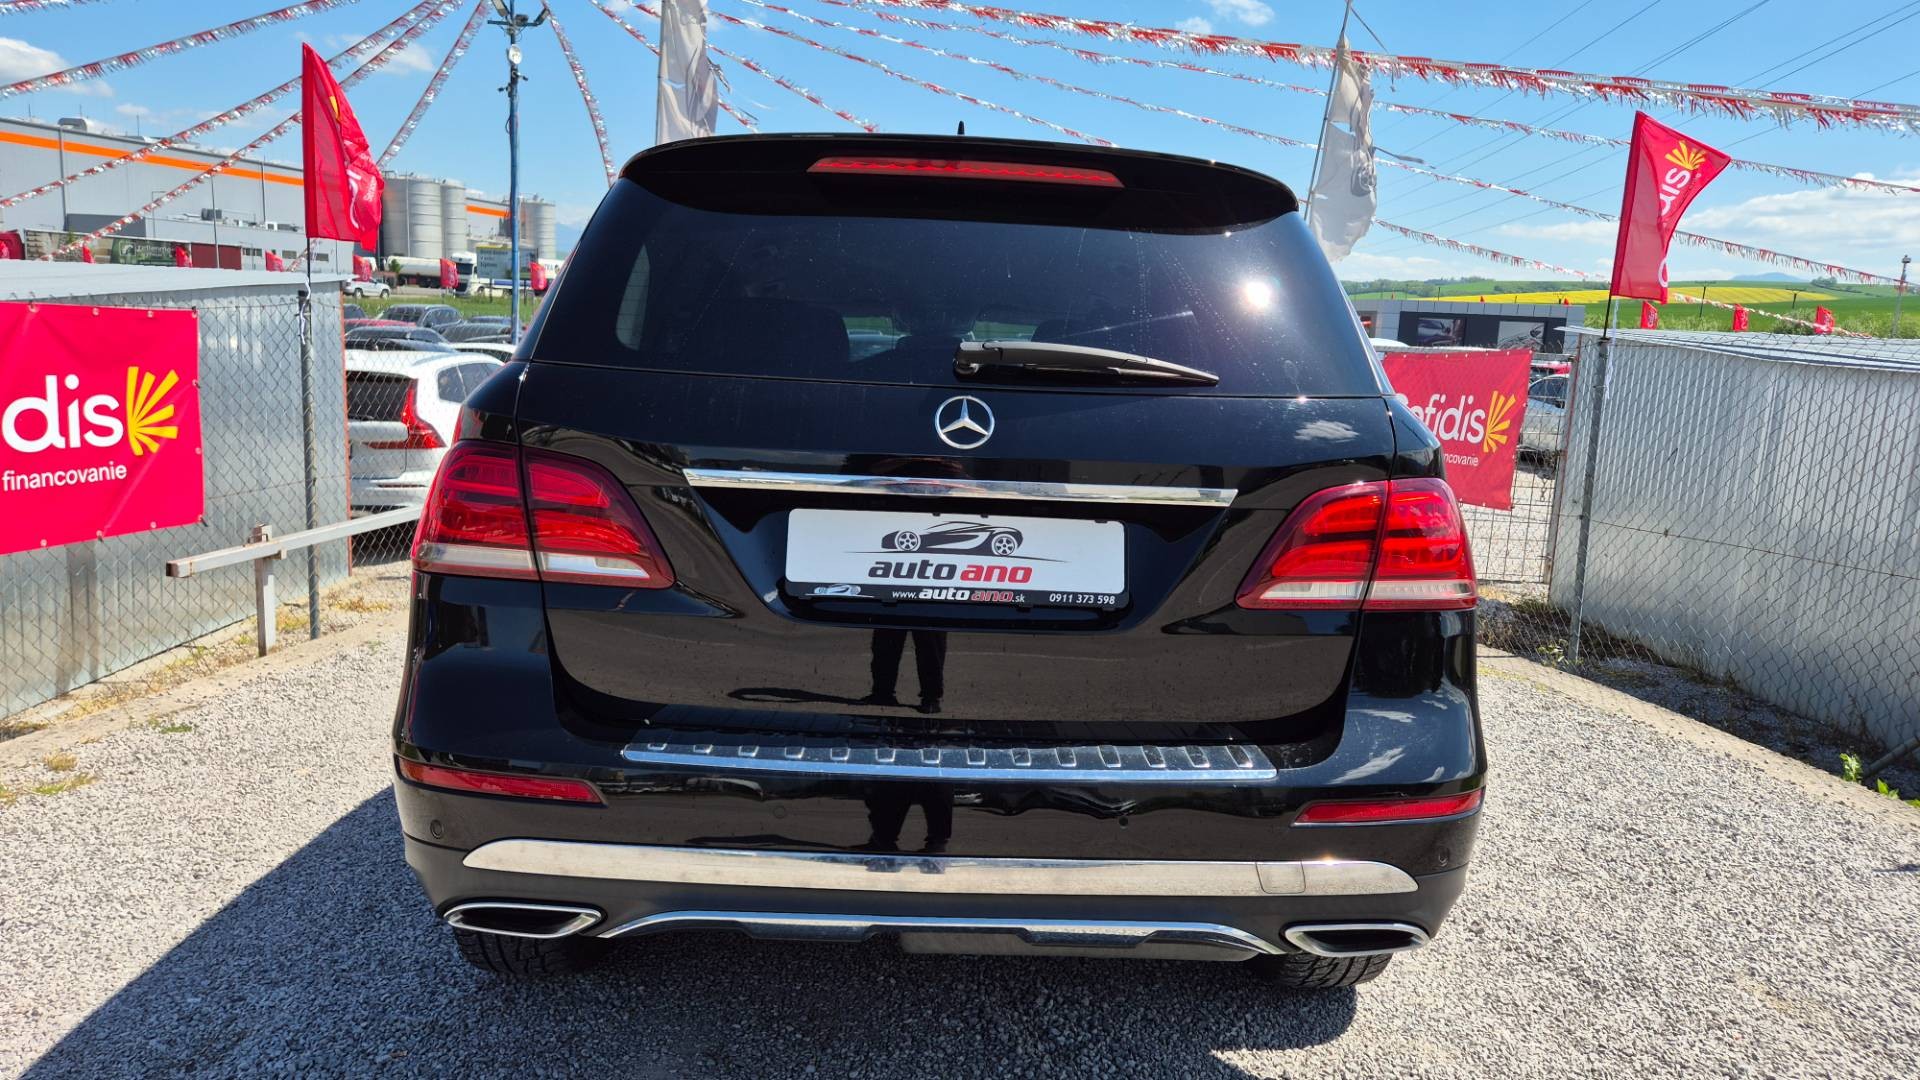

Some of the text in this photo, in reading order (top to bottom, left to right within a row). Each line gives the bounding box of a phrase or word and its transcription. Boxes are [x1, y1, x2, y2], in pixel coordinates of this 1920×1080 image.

[2, 374, 124, 453] dis
[2, 461, 127, 491] financovanie
[1049, 593, 1116, 605] 0911 373 598
